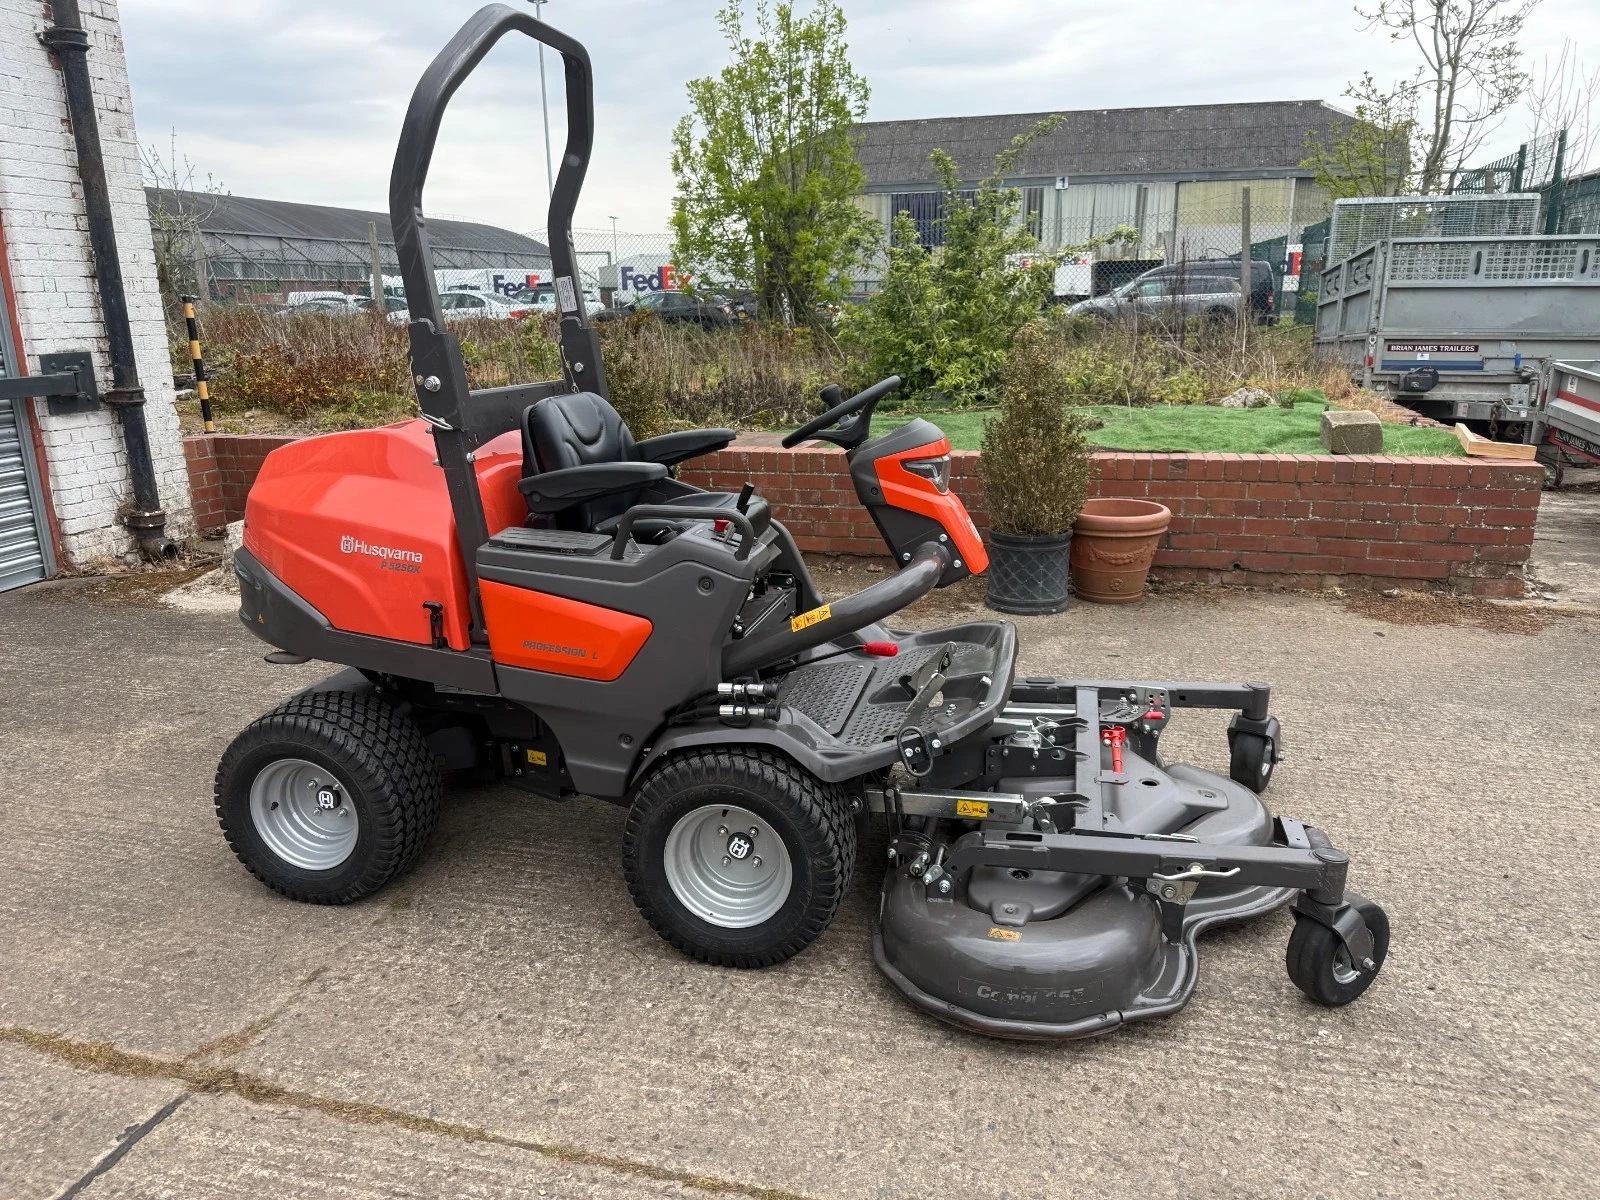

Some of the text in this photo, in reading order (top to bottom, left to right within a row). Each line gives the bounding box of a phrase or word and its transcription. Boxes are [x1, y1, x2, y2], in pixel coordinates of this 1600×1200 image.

[1059, 176, 1066, 188] 1
[620, 265, 693, 291] FedEx
[354, 540, 423, 563] Husqvarna
